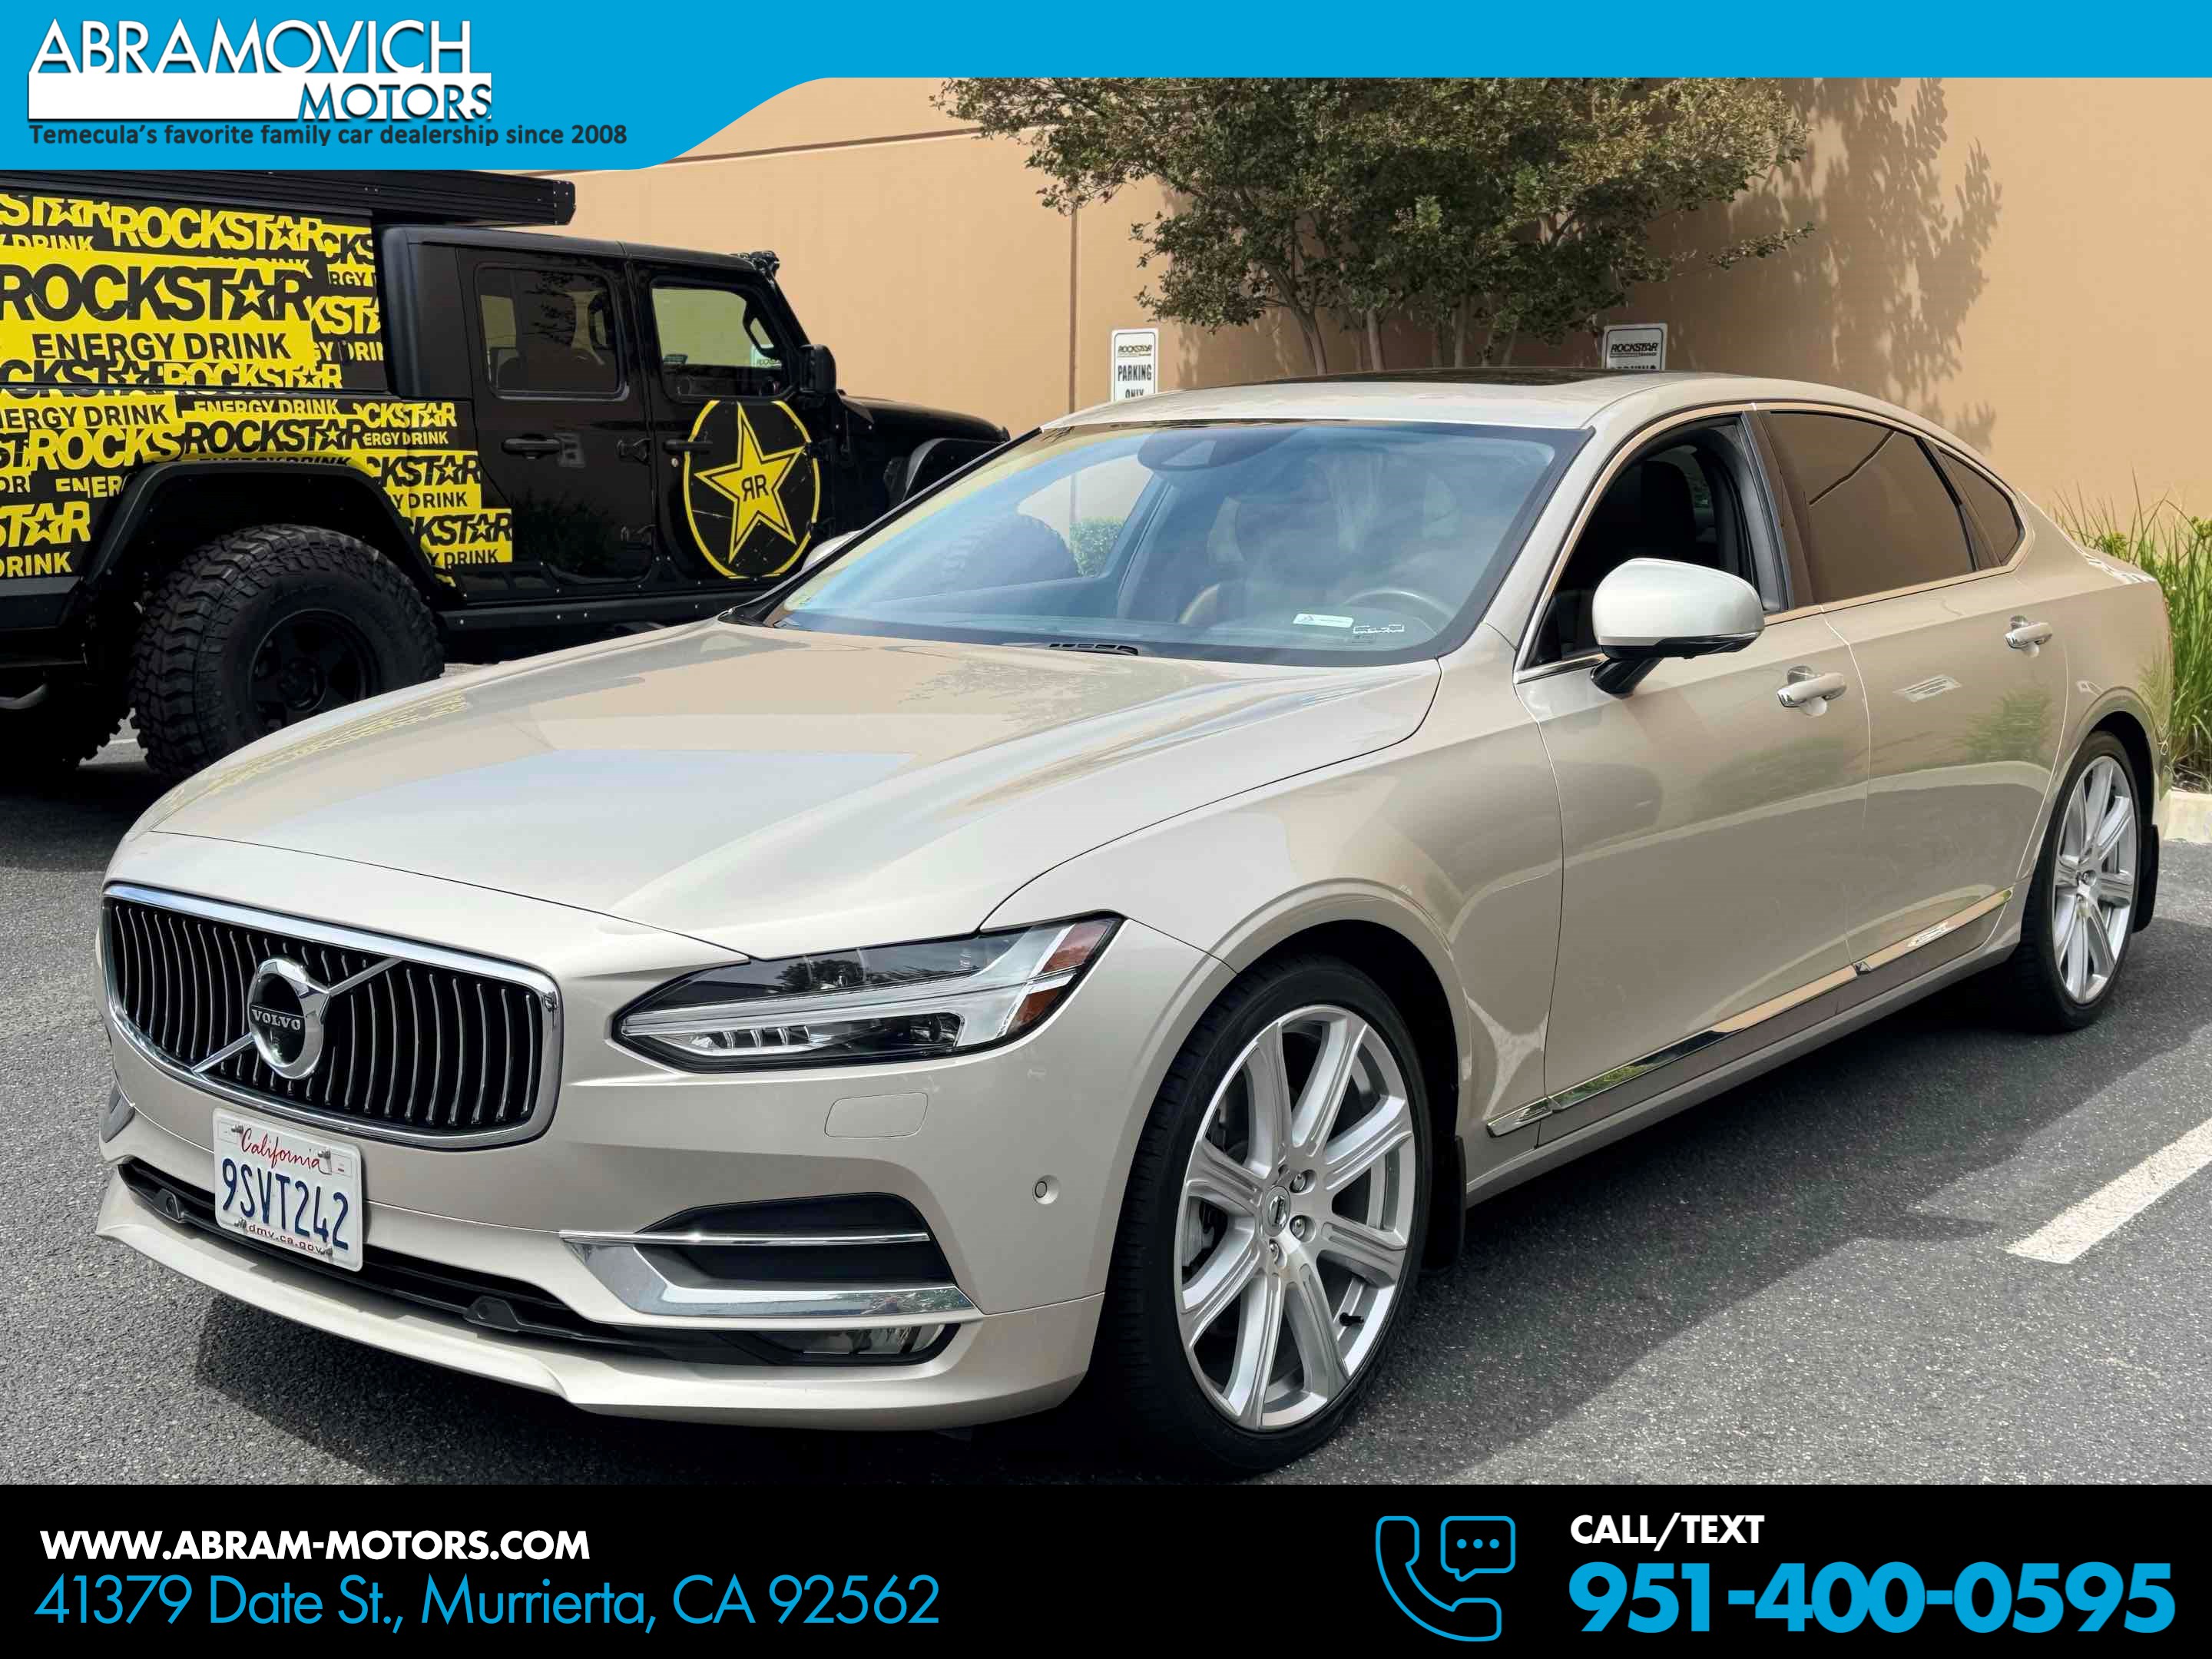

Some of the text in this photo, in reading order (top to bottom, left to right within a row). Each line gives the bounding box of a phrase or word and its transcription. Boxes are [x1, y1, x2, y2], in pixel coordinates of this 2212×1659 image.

[111, 206, 326, 252] ROCKSTAR
[0, 263, 311, 323] ROCKSTAR
[31, 333, 293, 360] ENERGY DRINK
[1611, 343, 1659, 353] ROCKSTAR
[1118, 363, 1152, 382] PARKING
[0, 404, 170, 429] ERGY DRINK
[184, 419, 364, 455] ROCKSTAR
[402, 430, 449, 445] DRINK
[409, 492, 468, 509] DRINK
[445, 549, 498, 567] DRINK
[251, 1008, 301, 1031] VOLVO
[240, 1128, 332, 1175] California
[222, 1158, 349, 1251] 9SVT242
